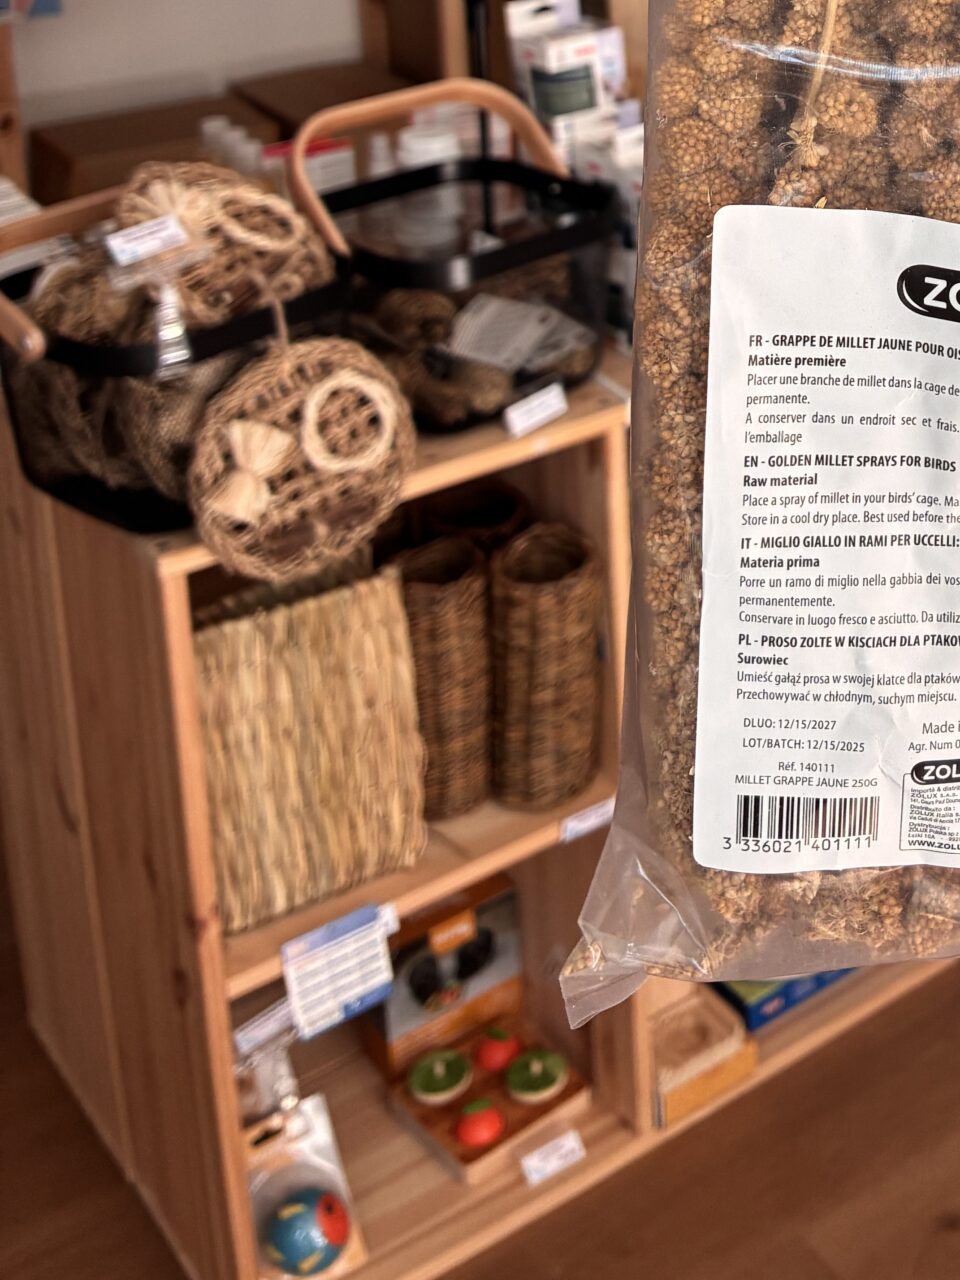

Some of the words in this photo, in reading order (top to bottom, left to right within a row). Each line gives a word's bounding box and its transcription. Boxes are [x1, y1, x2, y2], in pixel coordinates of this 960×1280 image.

[749, 335, 762, 346] FR
[772, 335, 816, 347] GRAPPE
[820, 336, 833, 347] DE
[836, 337, 875, 348] MILLET
[877, 338, 912, 351] JAUNE
[916, 342, 944, 356] POUR
[749, 355, 792, 366] Matière
[795, 356, 846, 368] première
[748, 374, 777, 385] Placer
[780, 376, 798, 385] une
[801, 374, 840, 385] branche
[843, 375, 855, 386] de
[858, 376, 886, 387] millet
[889, 376, 911, 388] dans
[914, 378, 922, 389] la
[925, 383, 946, 396] cage
[949, 385, 960, 396] de
[747, 394, 810, 407] permanente.
[746, 413, 752, 424] A
[758, 414, 806, 424] conserver
[812, 413, 835, 424] dans
[842, 415, 853, 424] un
[860, 414, 895, 426] endroit
[901, 416, 916, 425] sec
[922, 417, 932, 427] et
[937, 418, 960, 432] frais.
[744, 457, 758, 467] EN
[768, 455, 811, 467] GOLDEN
[815, 455, 854, 466] MILLET
[856, 456, 897, 467] SPRAYS
[900, 456, 921, 467] FOR
[924, 457, 956, 472] BIRDS
[744, 476, 767, 487] Raw
[771, 474, 817, 486] material
[743, 495, 768, 506] Place
[771, 497, 777, 506] a
[780, 496, 805, 507] spray
[808, 493, 818, 504] of
[821, 493, 849, 504] millet
[852, 493, 861, 504] in
[864, 495, 885, 506] your
[916, 496, 941, 506] cage.
[741, 538, 751, 548] IT
[761, 537, 799, 548] MIGLIO
[803, 536, 841, 547] GIALLO
[845, 536, 856, 547] IN
[859, 535, 887, 547] RAMI
[891, 535, 910, 546] PER
[914, 535, 960, 547] UCCELLI:
[741, 557, 783, 568] Materia
[787, 556, 819, 570] prima
[739, 634, 751, 646] PL
[761, 636, 797, 648] PROSO
[800, 637, 832, 648] ZOLTE
[835, 636, 845, 647] W
[848, 636, 897, 648] KISCIACH
[900, 636, 920, 647] DLA
[738, 653, 789, 665] Surowiec
[737, 671, 772, 683] Umieść
[775, 673, 800, 686] gałąź
[804, 676, 830, 686] prosa
[833, 675, 841, 683] w
[843, 674, 874, 688] swojej
[877, 674, 905, 685] klatce
[908, 673, 921, 684] dla
[744, 718, 775, 728] DLUO:
[779, 720, 836, 730] 12/15/2027
[922, 721, 954, 734] Made
[743, 738, 804, 749] LOT/BATCH:
[808, 740, 864, 752] 12/15/2025
[908, 742, 927, 753] Agr.
[930, 741, 952, 750] Num
[779, 762, 796, 771] Réf.
[801, 763, 834, 772] 140111
[735, 775, 771, 784] MILLET
[774, 776, 813, 786] GRAPPE
[816, 779, 849, 787] JAUNE
[852, 779, 877, 787] 250G
[723, 837, 732, 849] 3
[741, 839, 801, 853] 336021
[812, 836, 871, 851] 401111
